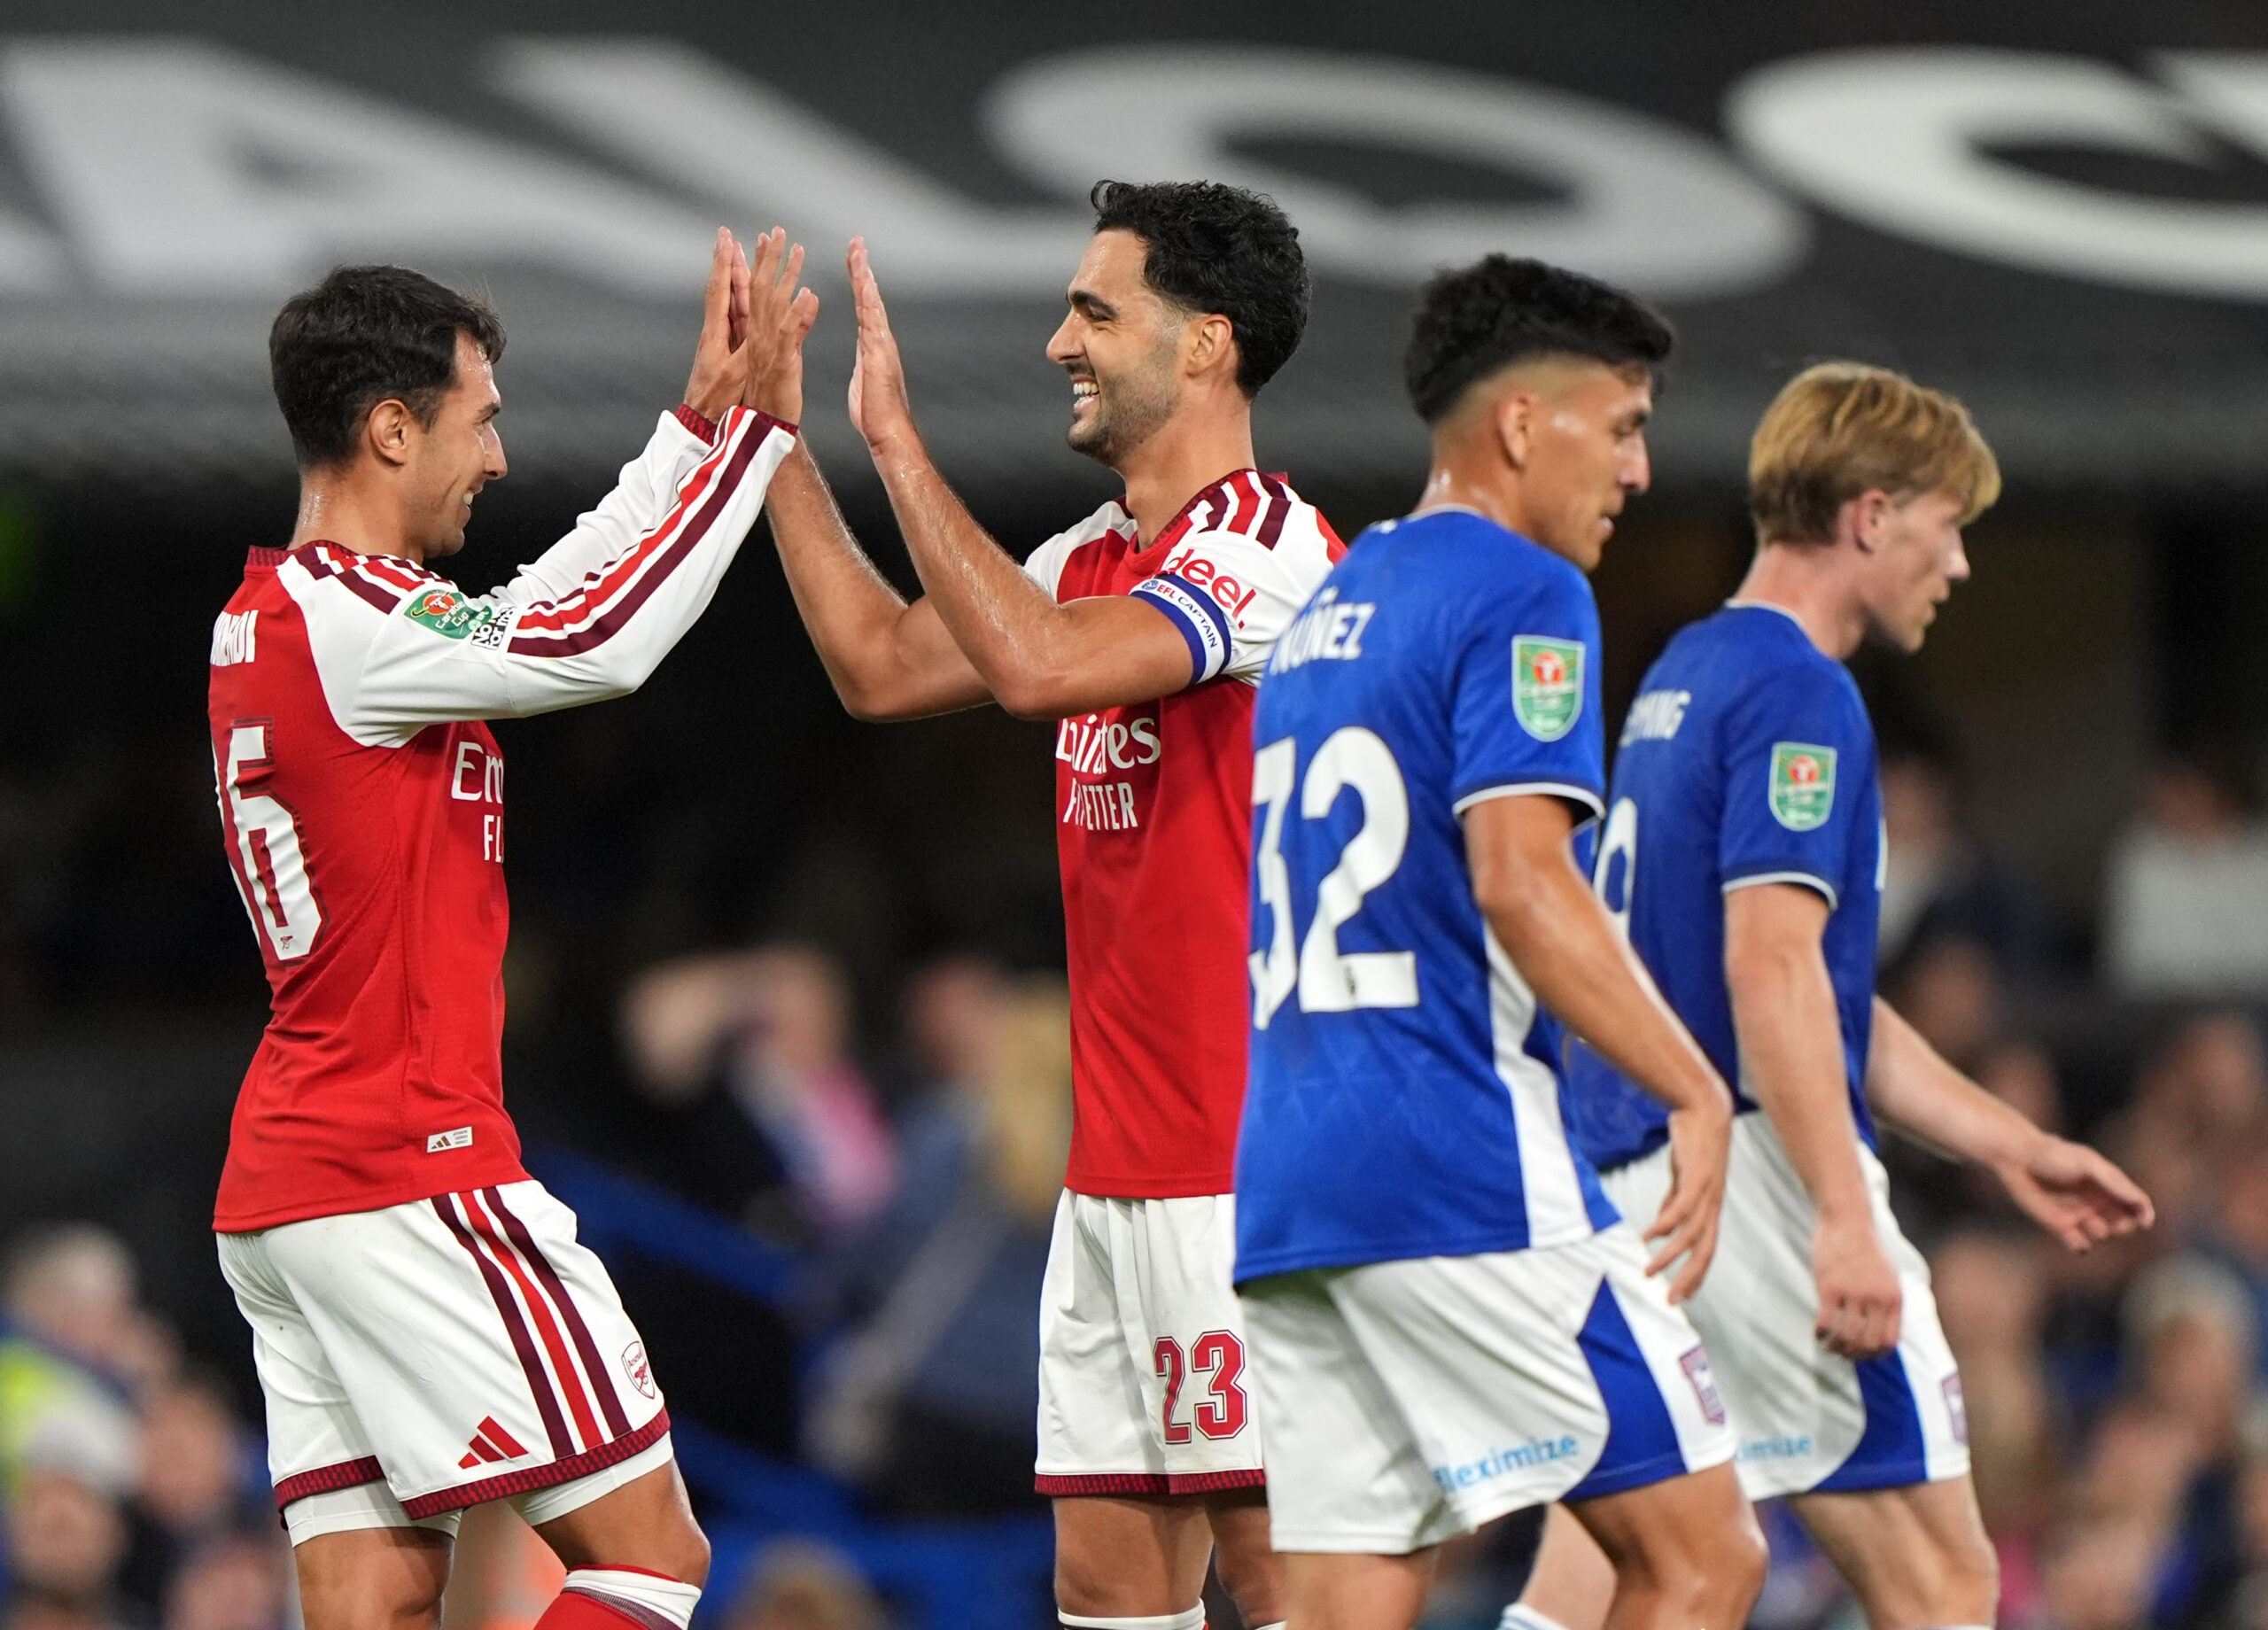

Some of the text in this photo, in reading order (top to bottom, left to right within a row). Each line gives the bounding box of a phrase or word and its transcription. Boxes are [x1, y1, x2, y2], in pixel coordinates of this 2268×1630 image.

[435, 601, 466, 629] Caraba
[451, 611, 470, 627] Cup
[1156, 584, 1218, 648] EFL CAPTAIN
[212, 720, 326, 962] 6
[1247, 726, 1419, 1031] 32
[1153, 1329, 1248, 1445] 23
